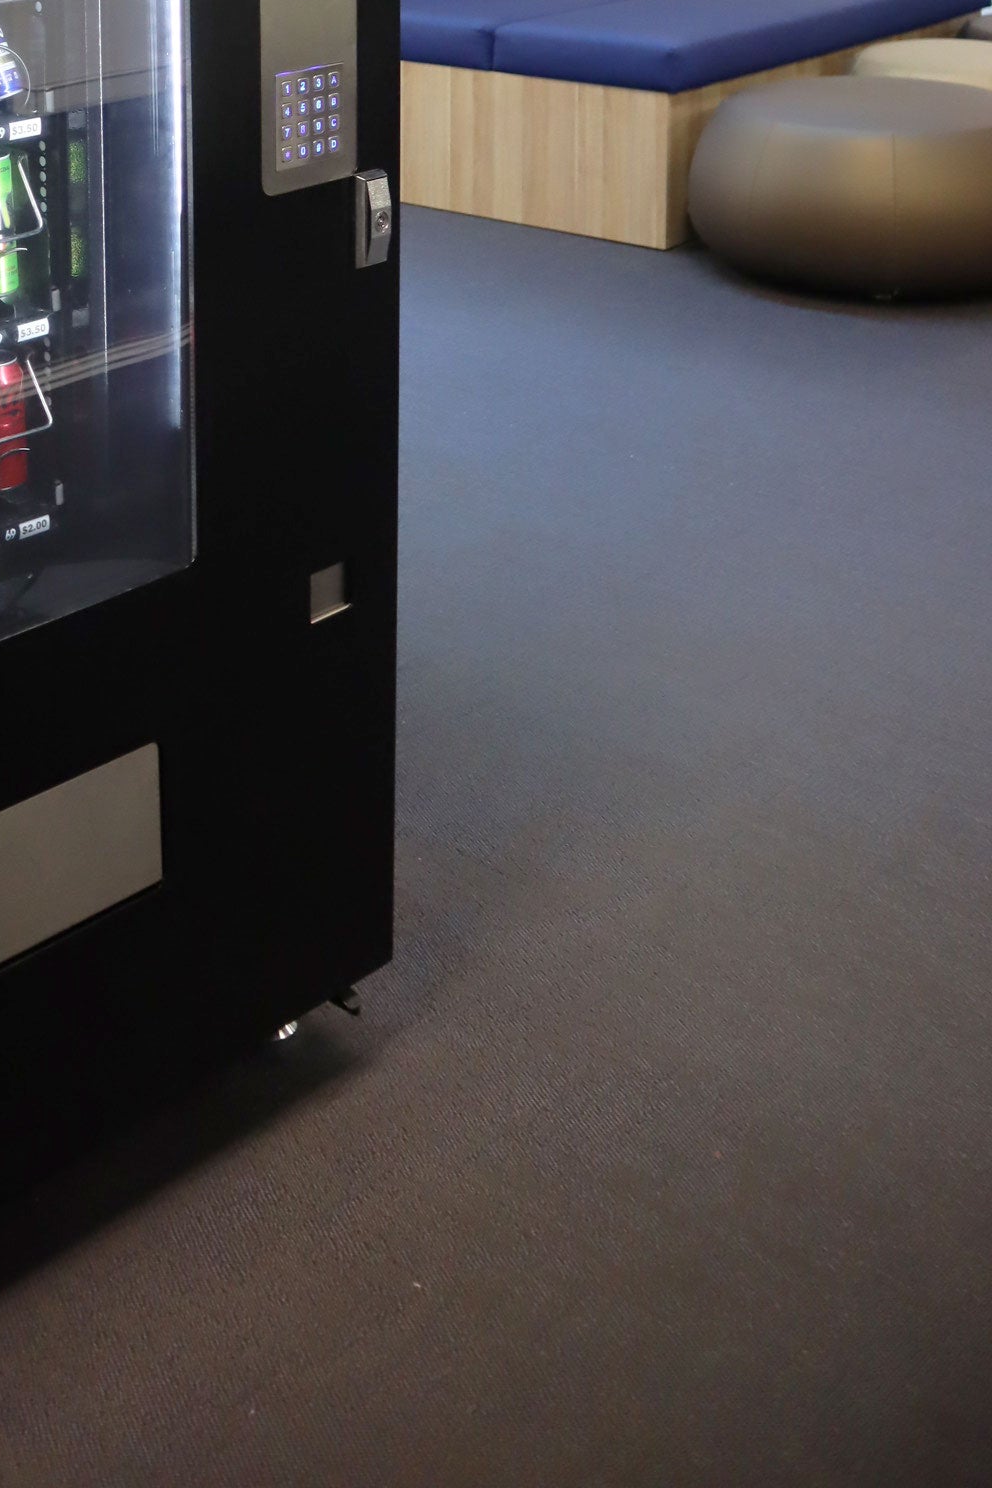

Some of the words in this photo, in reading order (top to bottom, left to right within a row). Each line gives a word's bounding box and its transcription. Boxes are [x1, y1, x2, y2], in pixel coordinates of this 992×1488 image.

[12, 123, 39, 136] $3.50
[20, 323, 46, 338] $3.50
[4, 527, 17, 541] 69
[21, 518, 48, 536] $2.00
